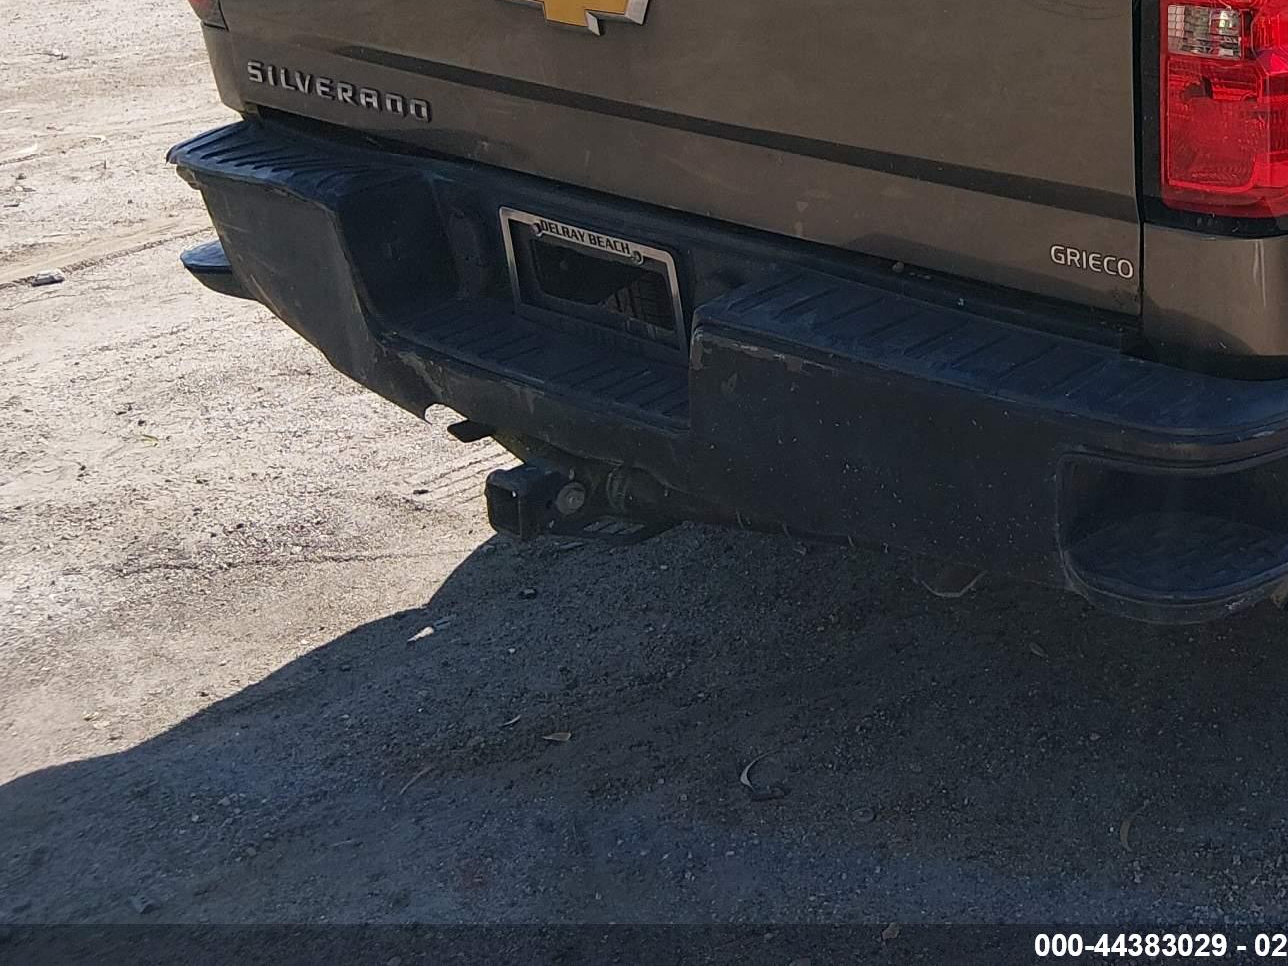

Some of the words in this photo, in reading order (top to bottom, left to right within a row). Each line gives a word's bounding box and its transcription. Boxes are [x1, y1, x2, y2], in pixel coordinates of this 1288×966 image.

[247, 60, 432, 123] SILVERADO
[540, 219, 586, 242] DELRAY
[588, 235, 631, 255] BEACH
[1050, 244, 1134, 280] GRIECO
